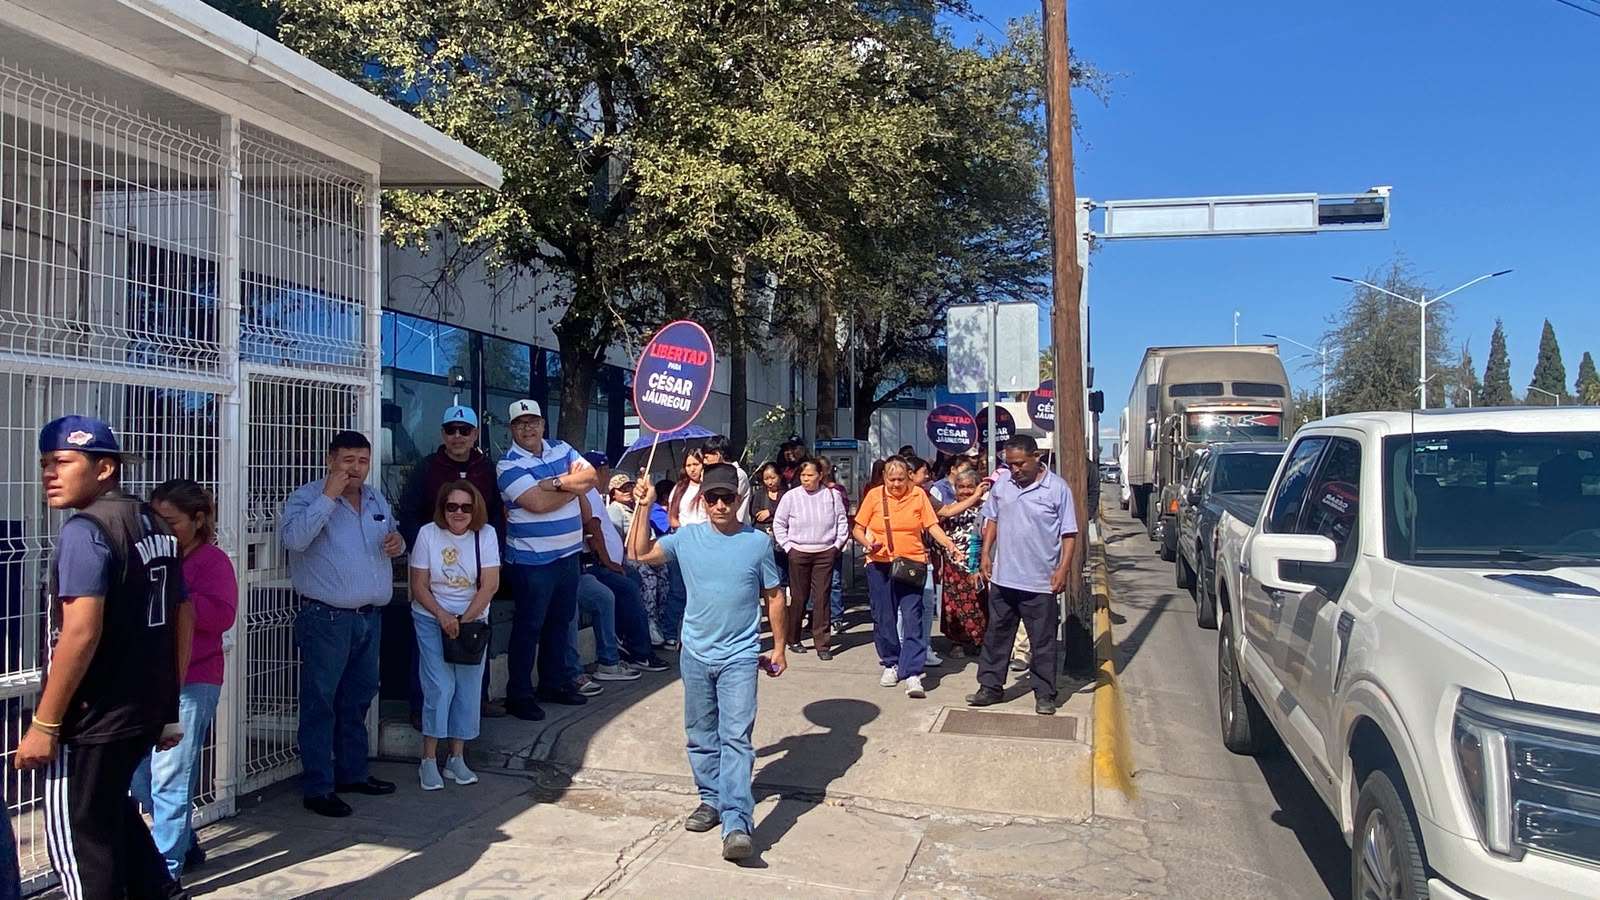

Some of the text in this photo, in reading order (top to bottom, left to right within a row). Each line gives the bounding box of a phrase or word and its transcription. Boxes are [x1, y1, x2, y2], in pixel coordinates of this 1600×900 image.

[650, 343, 707, 366] LIBERTAD
[648, 370, 693, 396] CÉSAR
[641, 389, 691, 412] JÁUREGUI
[453, 409, 464, 418] A
[936, 427, 968, 438] CÉSAR
[148, 565, 166, 627] 7
